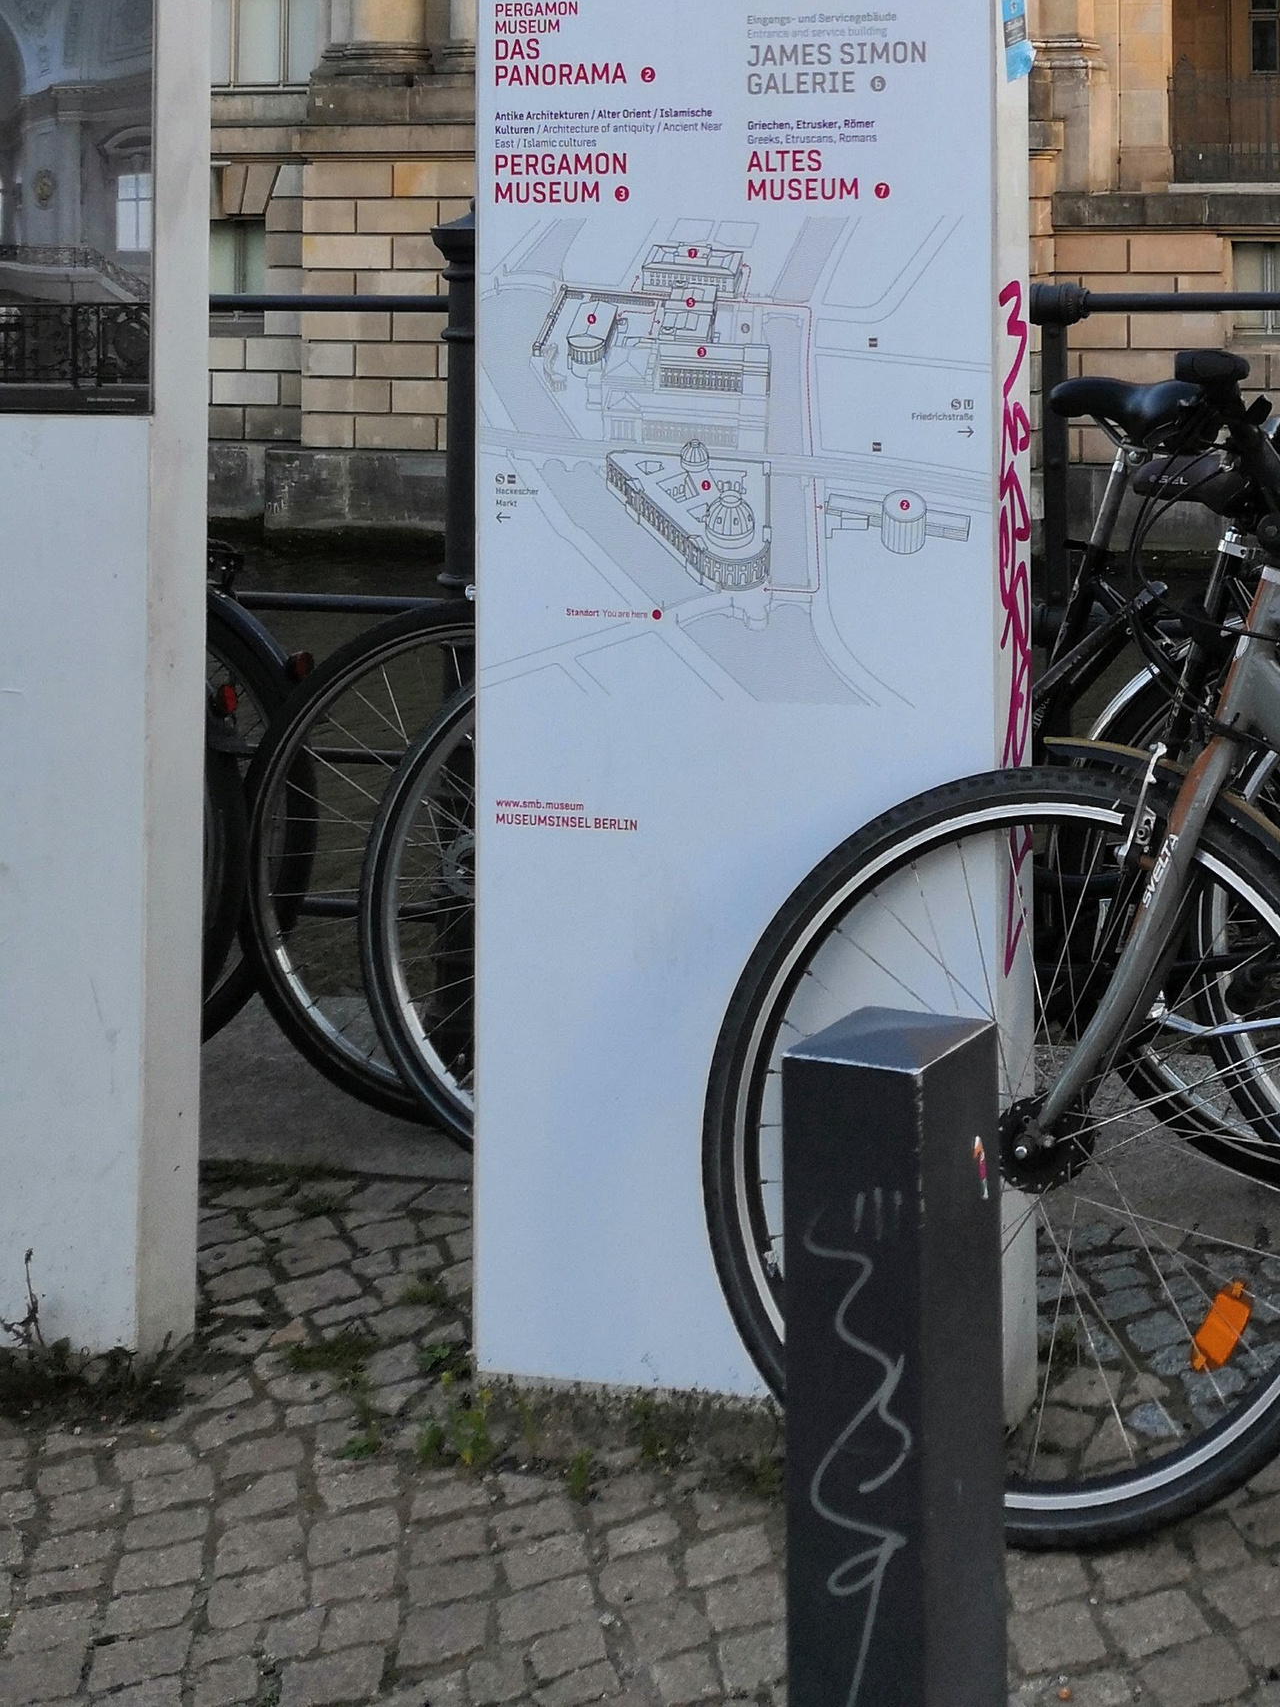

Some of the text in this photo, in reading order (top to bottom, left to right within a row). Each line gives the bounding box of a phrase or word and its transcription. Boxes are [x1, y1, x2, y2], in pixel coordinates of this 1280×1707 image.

[495, 1, 578, 17] PERGAMON
[495, 19, 560, 34] MUSEUM
[747, 12, 897, 26] Eingangs- und Servicegebäude
[495, 38, 540, 60] DAS
[747, 41, 926, 67] JAMES SIMON
[495, 63, 627, 86] PANORAMA
[747, 71, 855, 94] GALERIE
[495, 111, 524, 121] Antike
[526, 111, 589, 120] Architekturen
[598, 109, 620, 119] Alter
[623, 109, 651, 118] Orient
[659, 108, 712, 118] Islamische
[495, 125, 534, 135] Kulturen
[543, 123, 599, 134] Architecture
[602, 123, 610, 133] of
[613, 123, 655, 134] antiquity
[663, 123, 698, 132] Ancient
[701, 122, 722, 131] Near
[748, 119, 875, 131] Griechen, Etrusker, Römer
[495, 139, 514, 149] East
[523, 139, 557, 148] Islamic
[559, 138, 596, 148] cultures
[748, 134, 877, 145] Greeks, Etruscans, Romans
[495, 153, 627, 175] PERGAMON
[747, 150, 822, 172] ALTES
[495, 182, 599, 203] MUSEUM
[747, 178, 859, 200] MUSEUM
[912, 413, 973, 421] Friedrichstraße
[566, 608, 648, 618] Standort You are here
[496, 799, 584, 811] www.smb.museum
[496, 813, 637, 831] MUSEUMSINSEL BERLIN
[1142, 833, 1179, 909] SVELTA
